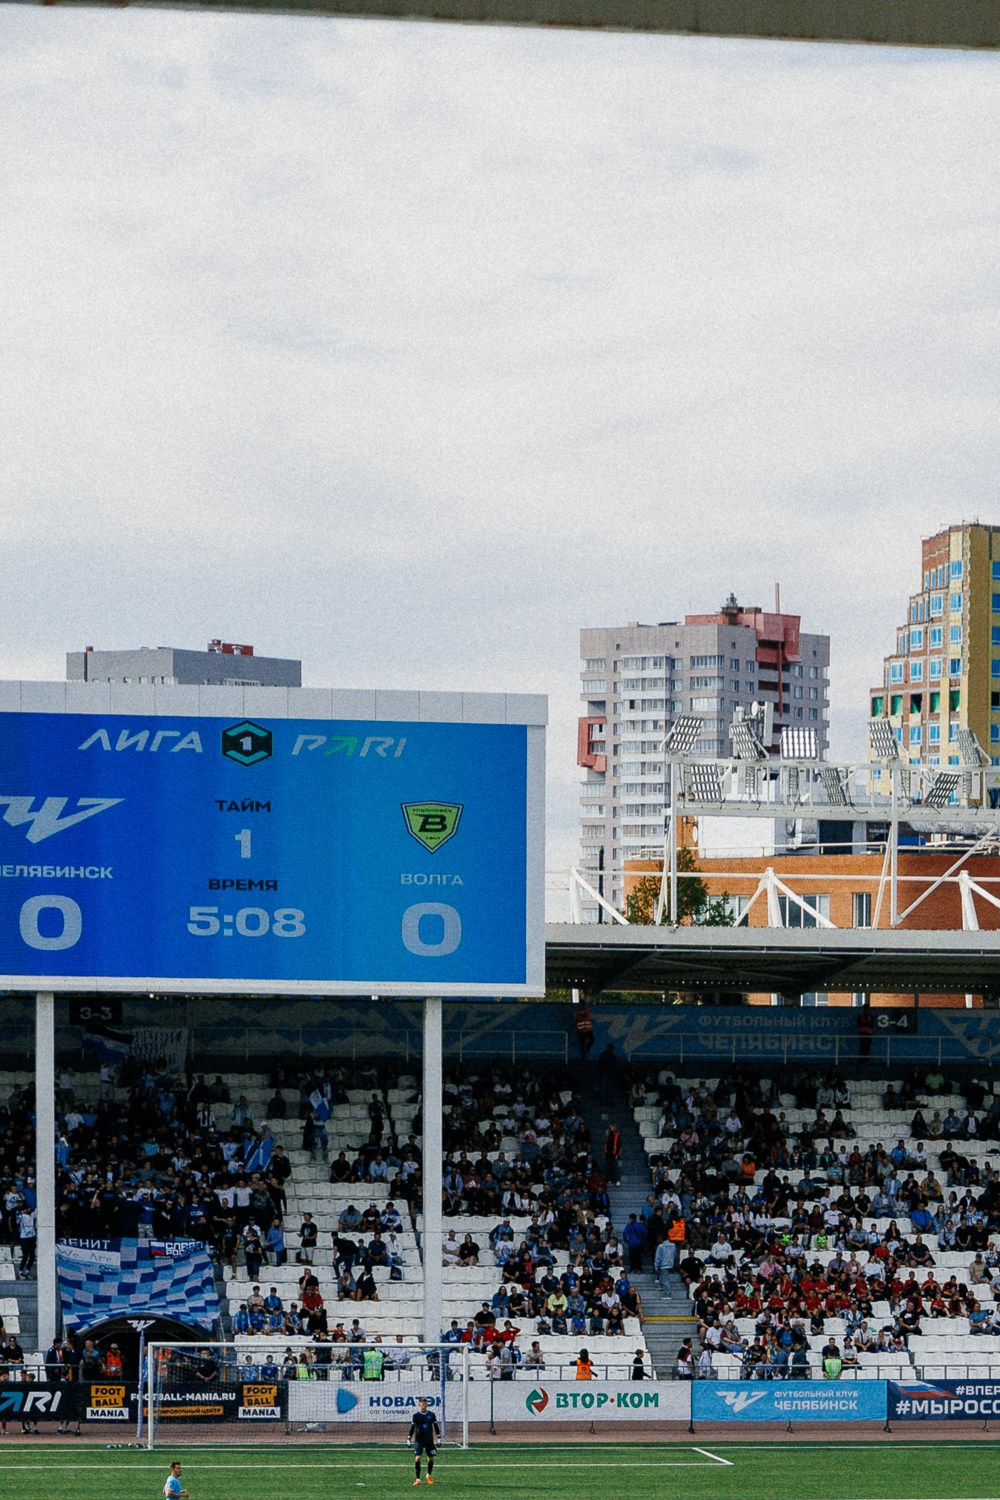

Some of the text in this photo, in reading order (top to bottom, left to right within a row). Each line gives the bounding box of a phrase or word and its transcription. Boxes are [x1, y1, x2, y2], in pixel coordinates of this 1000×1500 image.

[77, 728, 203, 753] ЛИГА
[215, 798, 272, 813] ТАЙМ
[234, 828, 252, 859] 1
[0, 865, 114, 879] ЕЛЯБИНСК
[208, 878, 279, 892] ВРЕМЯ
[400, 873, 464, 886] ВОЛГА
[19, 894, 83, 951] 0
[187, 905, 306, 938] 5:08
[401, 901, 462, 957] 0
[79, 1006, 113, 1020] 3-3
[698, 1013, 809, 1028] ФУТБОЛЬНЫЙ
[877, 1014, 909, 1028] 3-4
[59, 1237, 111, 1250] ЗЕНИТ
[94, 1387, 122, 1396] FOOT
[246, 1386, 273, 1395] FOOT
[774, 1389, 859, 1398] ФУТБОЛЬНЫЙ КЛУБ
[95, 1398, 119, 1407] BALL
[247, 1397, 271, 1406] BALL
[774, 1400, 858, 1410] ЧЕЛЯБИНСК
[90, 1409, 125, 1417] MANIA
[242, 1408, 277, 1417] MANIA
